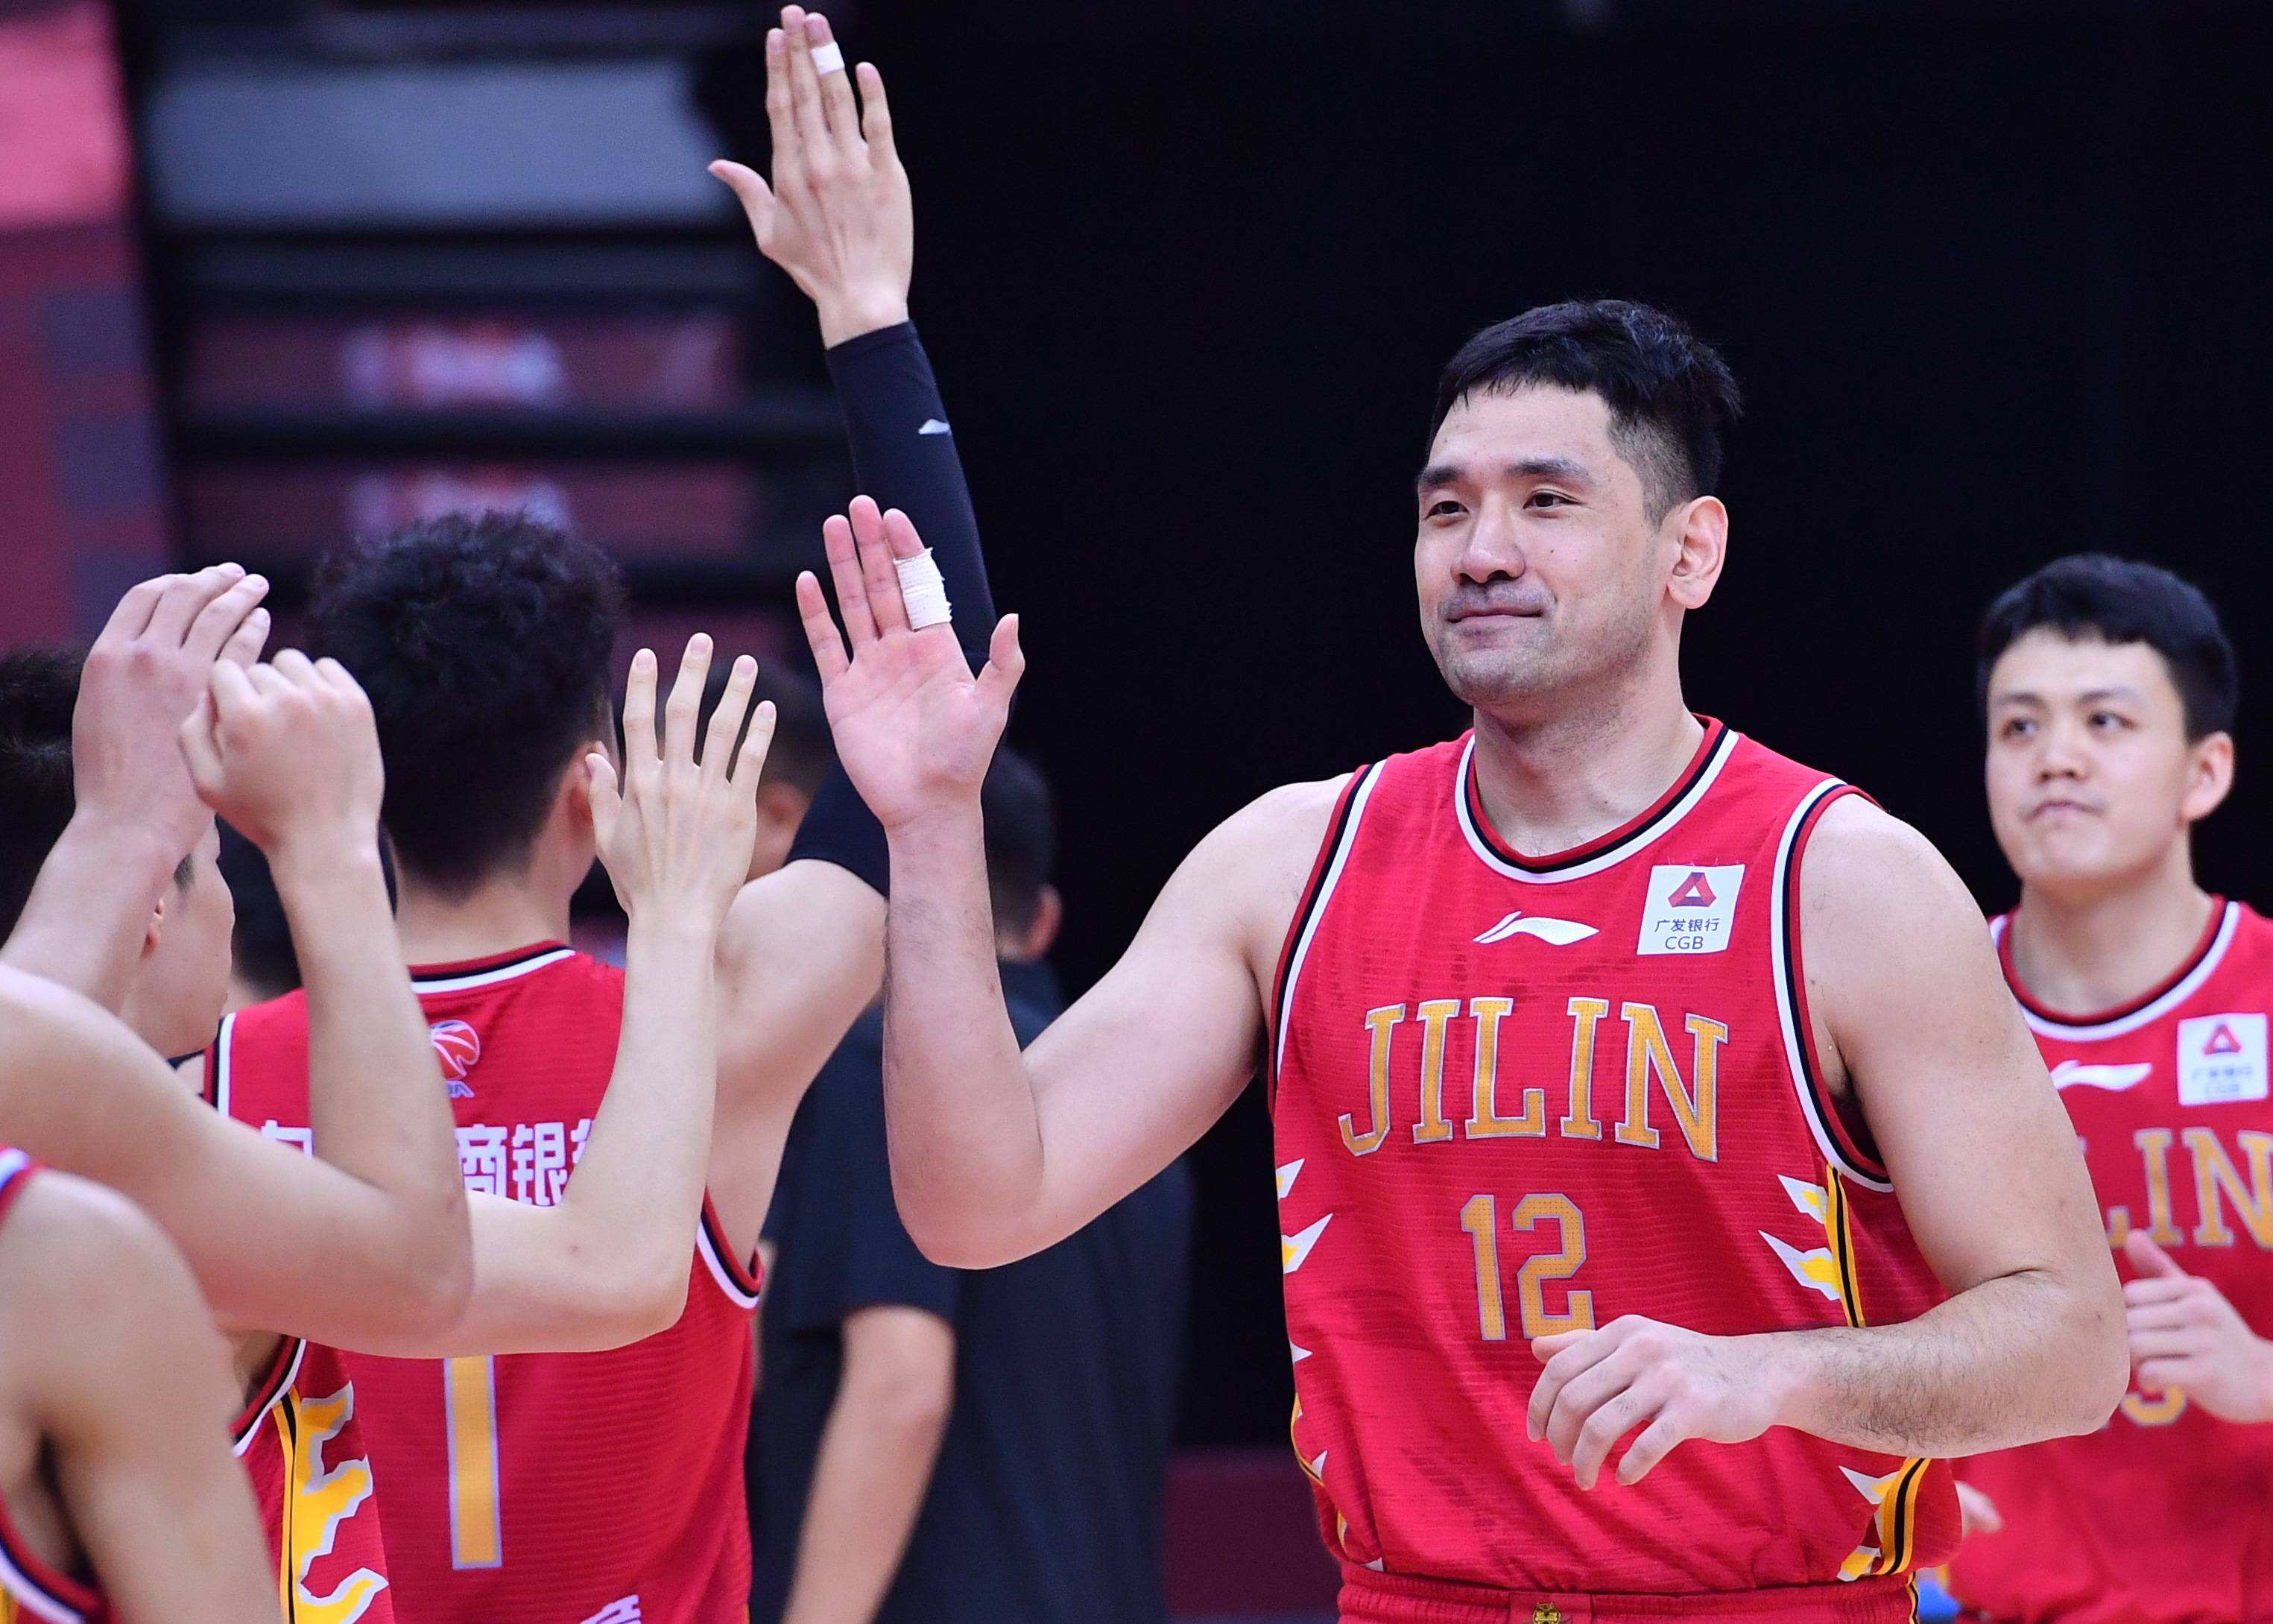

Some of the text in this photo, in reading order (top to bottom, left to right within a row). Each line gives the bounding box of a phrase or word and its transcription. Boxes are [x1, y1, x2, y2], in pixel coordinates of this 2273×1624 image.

[1654, 917, 1720, 932] 广发银行
[1664, 935, 1704, 950] CGB
[1338, 997, 1728, 1162] JILIN
[1460, 1193, 1596, 1340] 12
